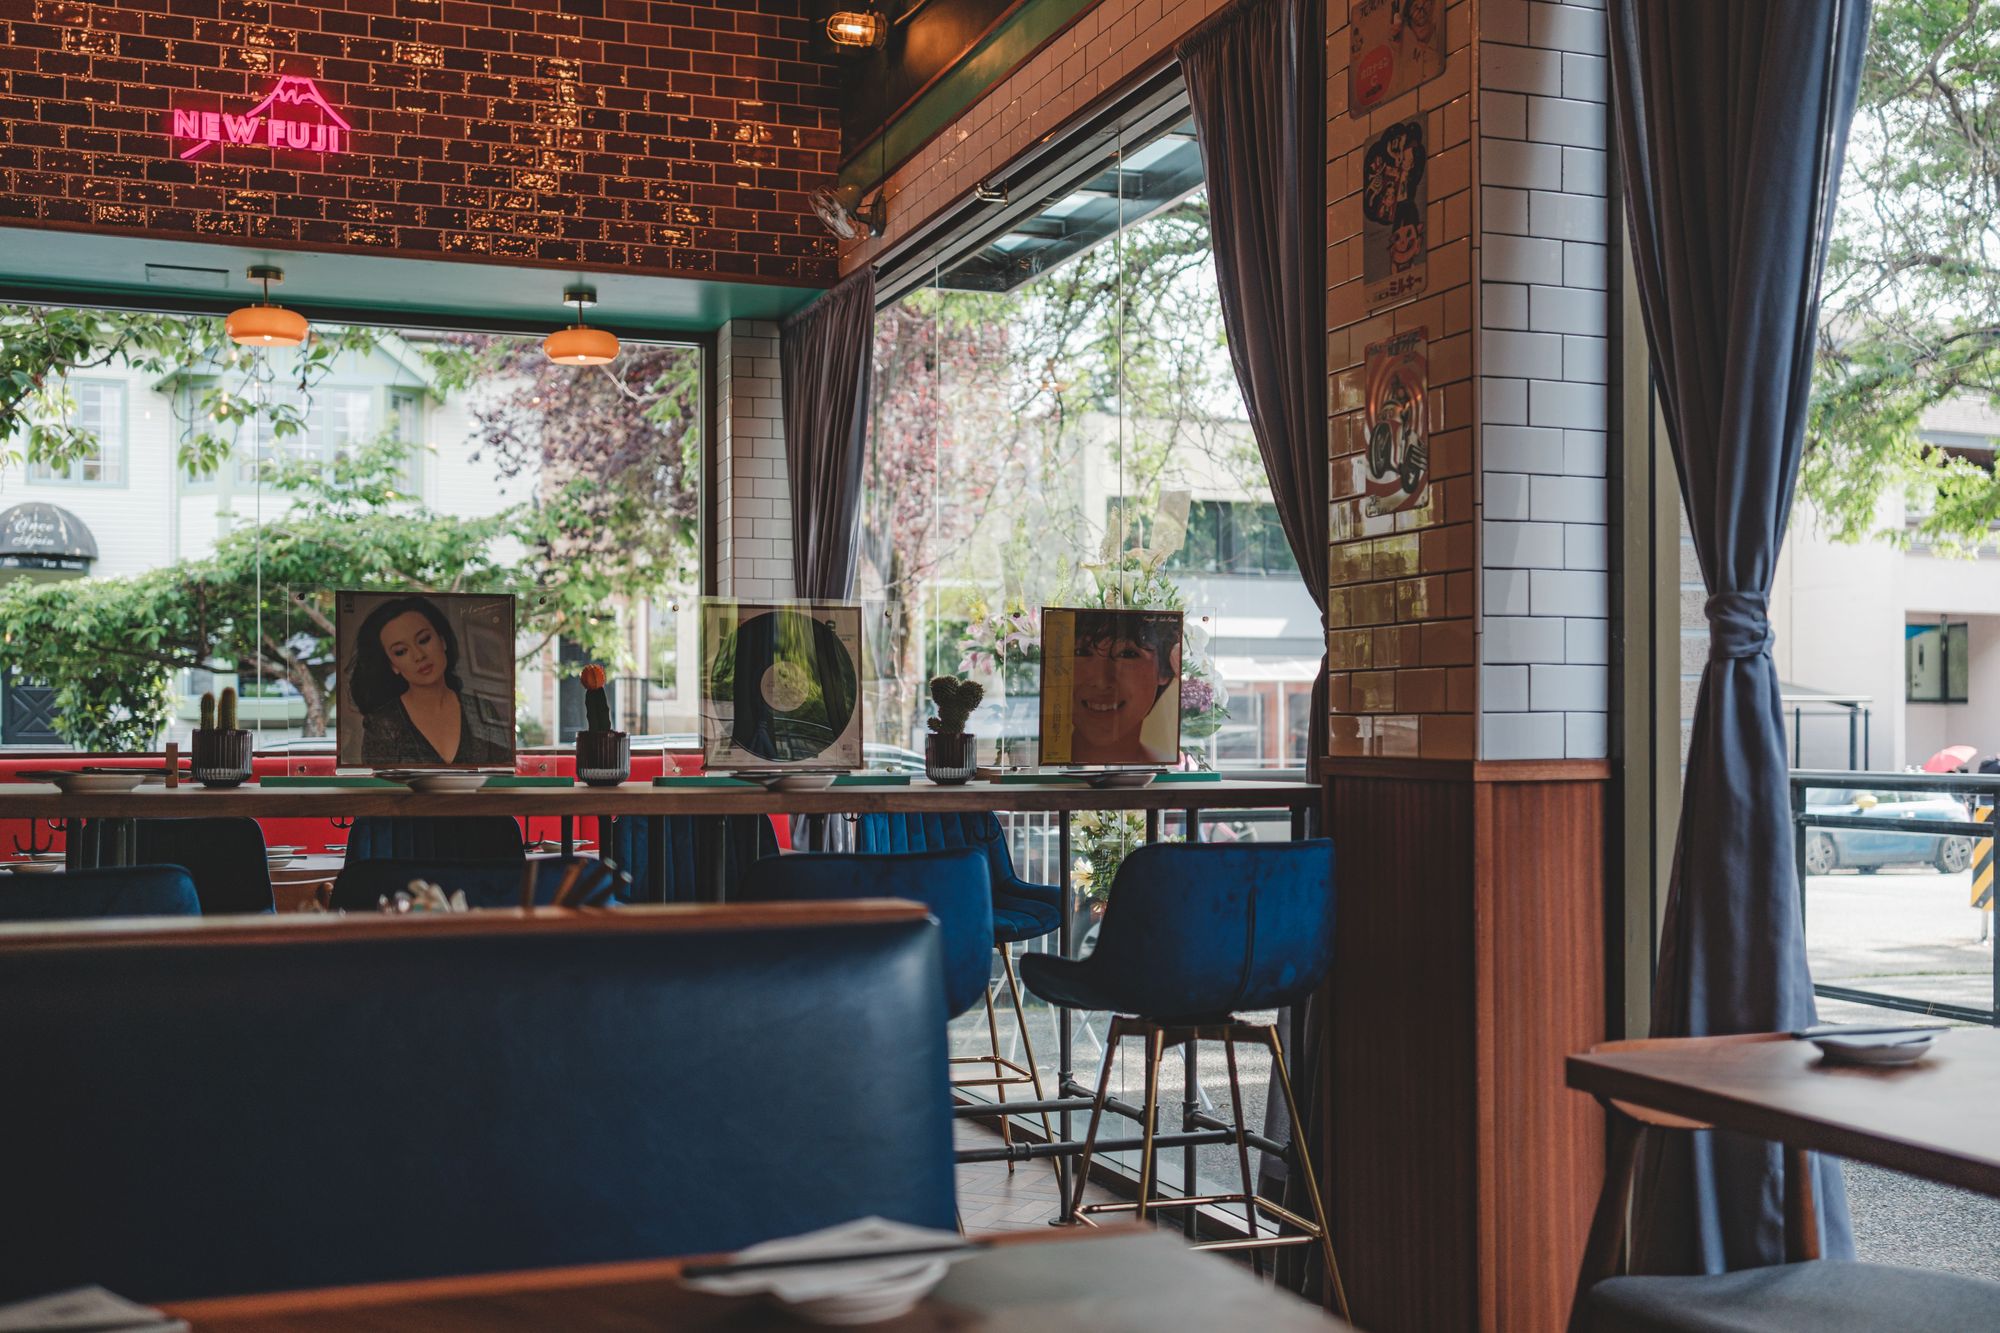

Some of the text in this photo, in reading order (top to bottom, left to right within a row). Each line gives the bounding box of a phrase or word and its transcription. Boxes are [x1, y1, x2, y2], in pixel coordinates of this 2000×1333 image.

[174, 108, 340, 153] NEW FUJI
[15, 518, 55, 533] Once
[11, 534, 55, 550] Again
